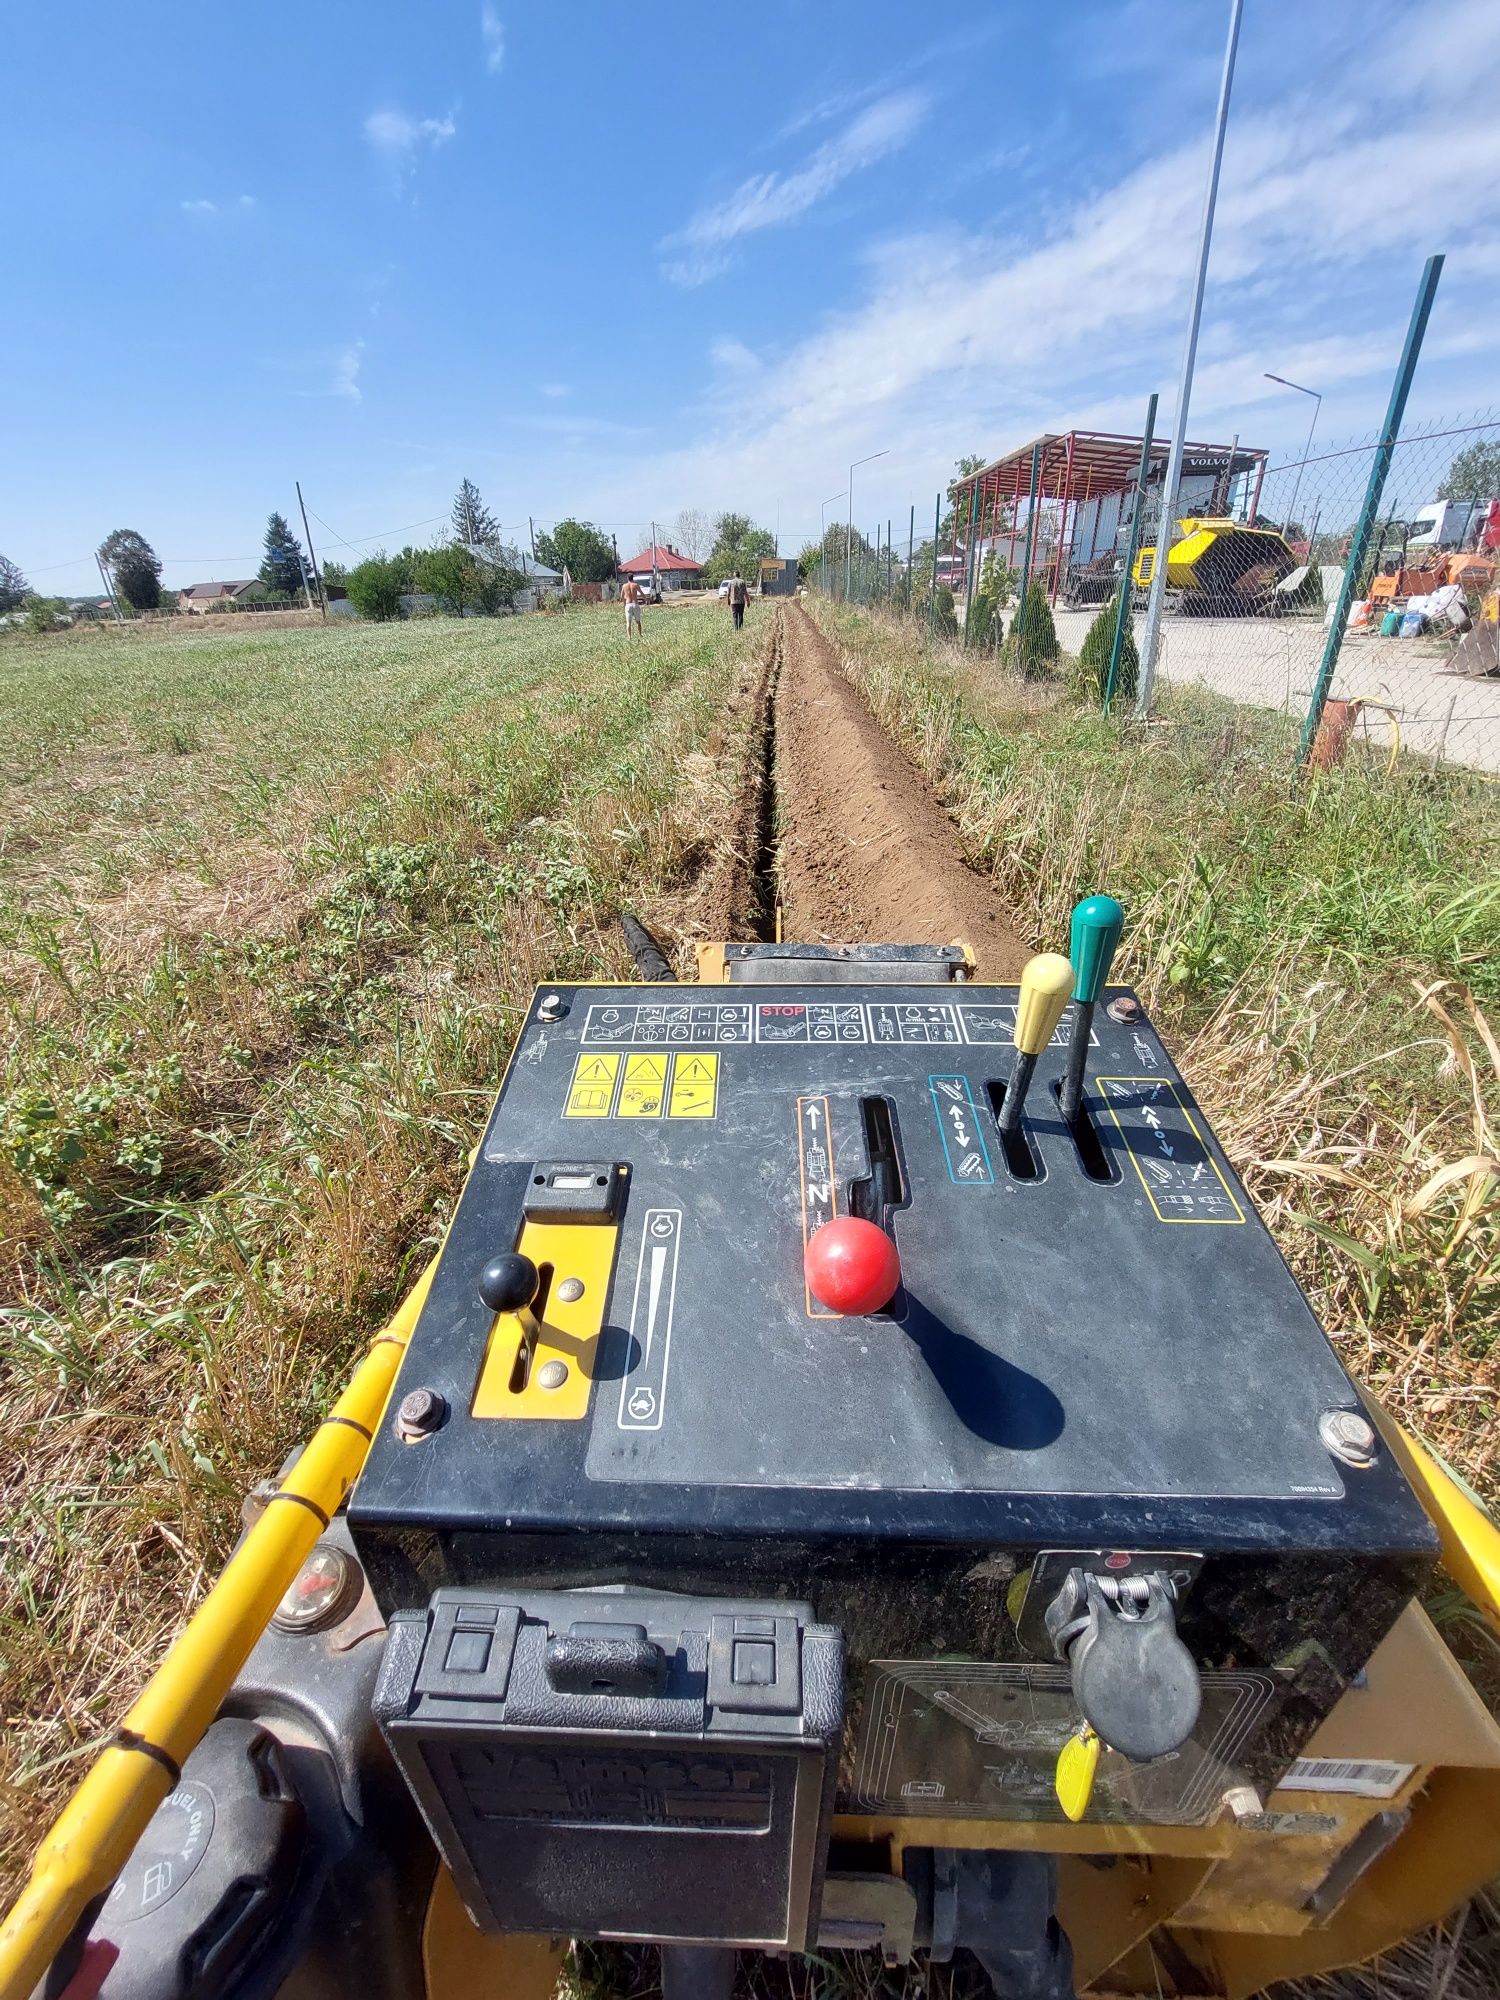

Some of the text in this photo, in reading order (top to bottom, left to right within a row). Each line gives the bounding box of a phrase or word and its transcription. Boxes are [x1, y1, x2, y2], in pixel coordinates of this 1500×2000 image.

[1190, 457, 1229, 466] VOLVO
[761, 1006, 805, 1016] STOP
[808, 1183, 829, 1203] N
[180, 1810, 203, 1862] ONLY
